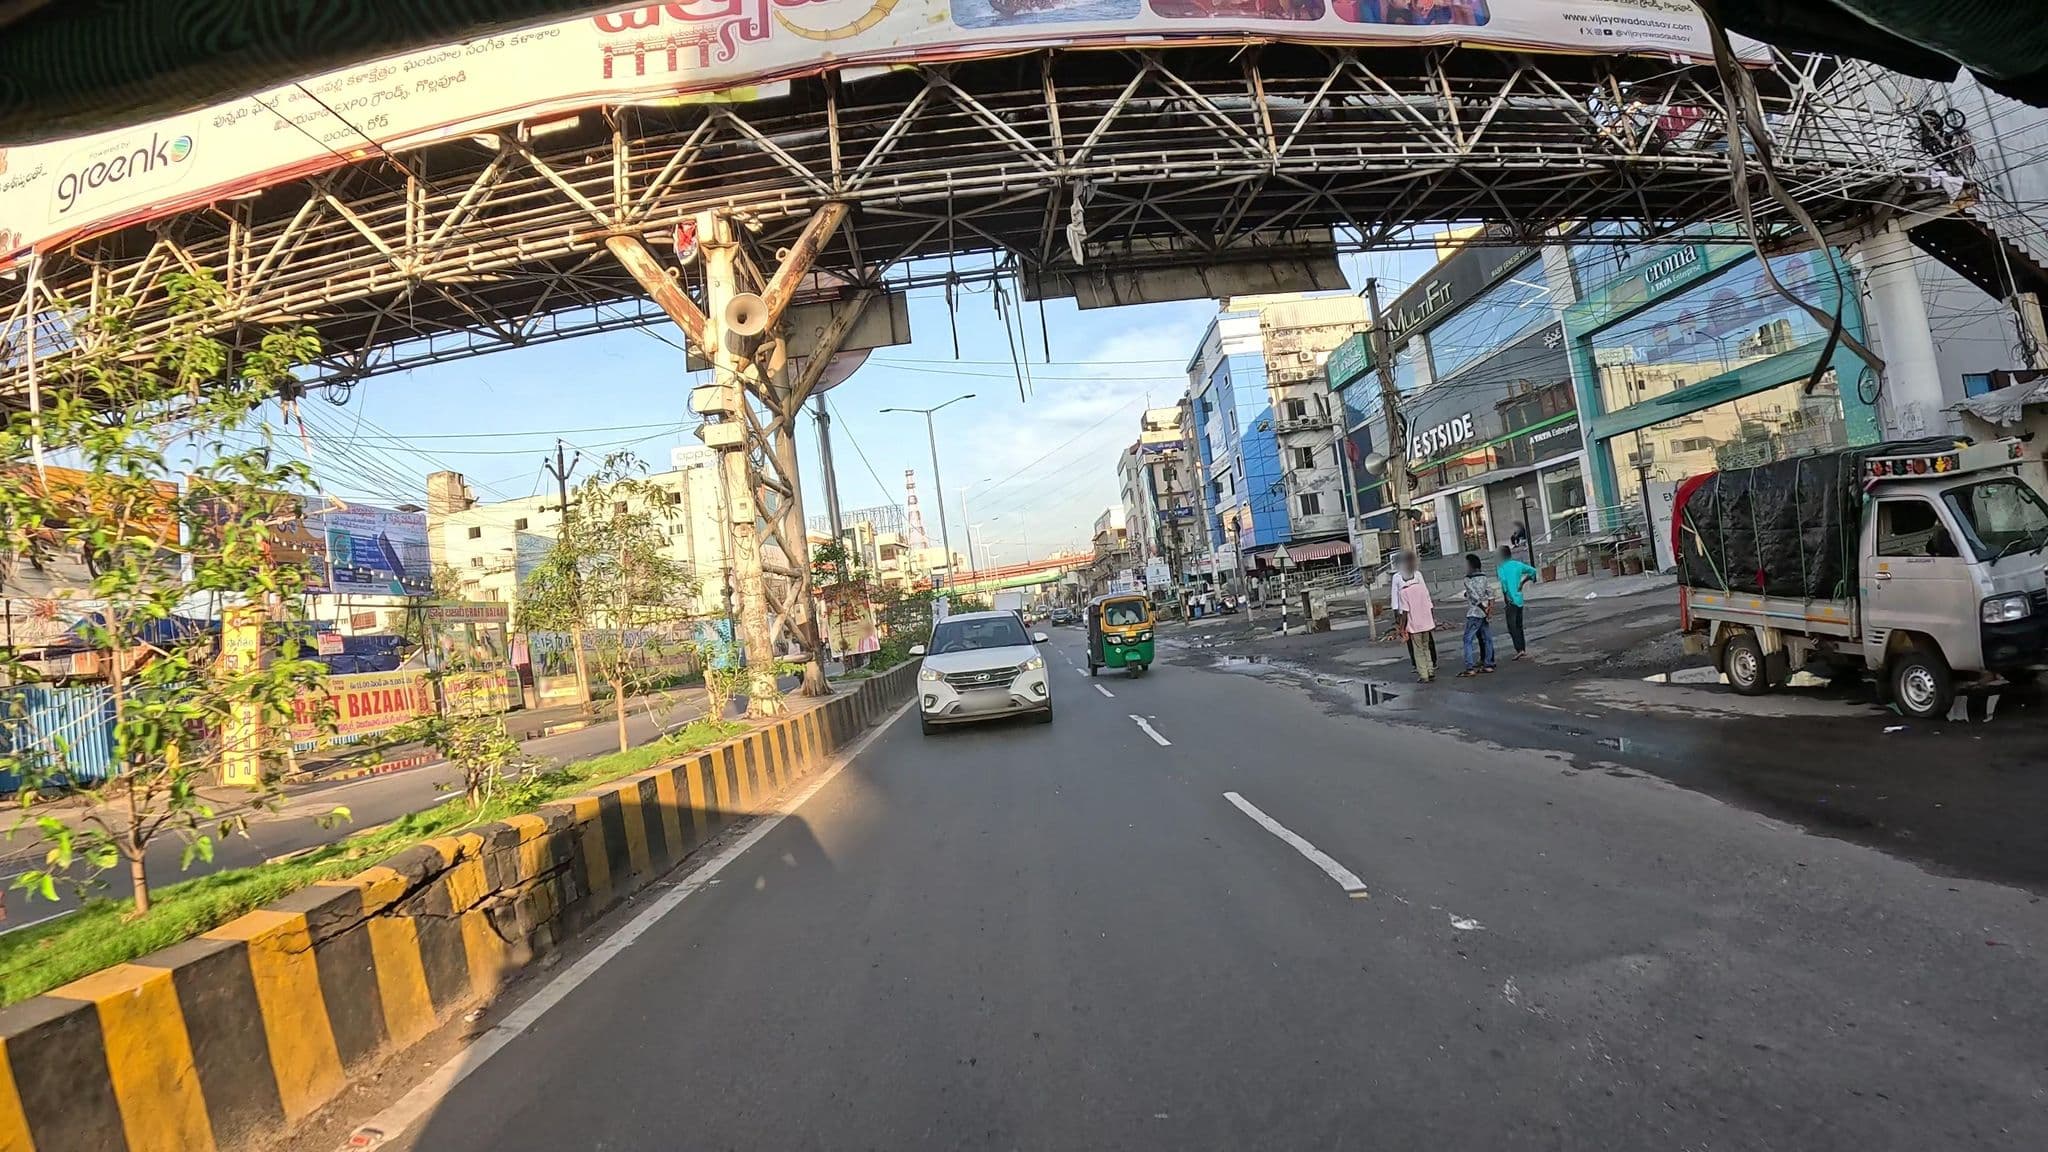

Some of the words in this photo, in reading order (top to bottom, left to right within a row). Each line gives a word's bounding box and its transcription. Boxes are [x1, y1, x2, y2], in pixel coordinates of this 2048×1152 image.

[1563, 13, 1693, 31] www.vijayawadautsav.com
[334, 97, 368, 114] EXPO
[58, 132, 193, 213] greenko
[1645, 244, 1697, 284] croma
[1655, 277, 1673, 290] TATA
[1535, 431, 1552, 443] TATA
